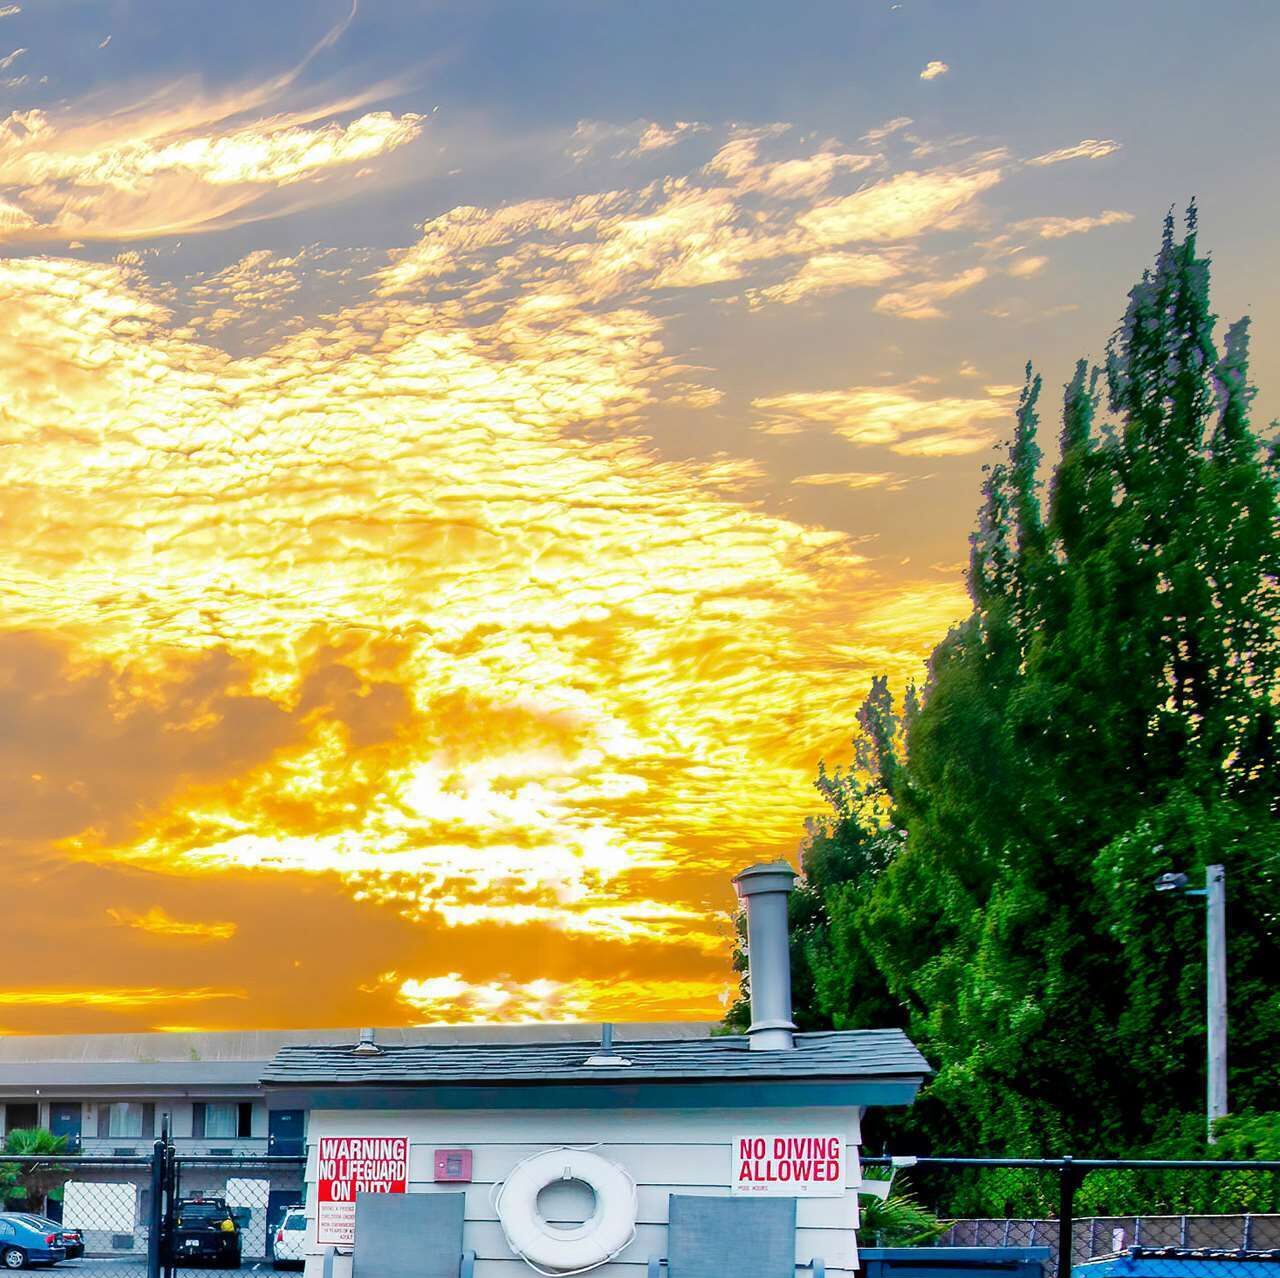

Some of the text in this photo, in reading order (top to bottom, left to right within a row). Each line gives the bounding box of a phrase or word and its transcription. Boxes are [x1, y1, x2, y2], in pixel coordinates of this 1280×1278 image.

[321, 1139, 405, 1160] WARNING
[740, 1138, 839, 1159] NO DIVING
[320, 1160, 405, 1180] NO LIFEGUARD
[739, 1160, 839, 1181] ALLOWED
[331, 1181, 350, 1200] ON
